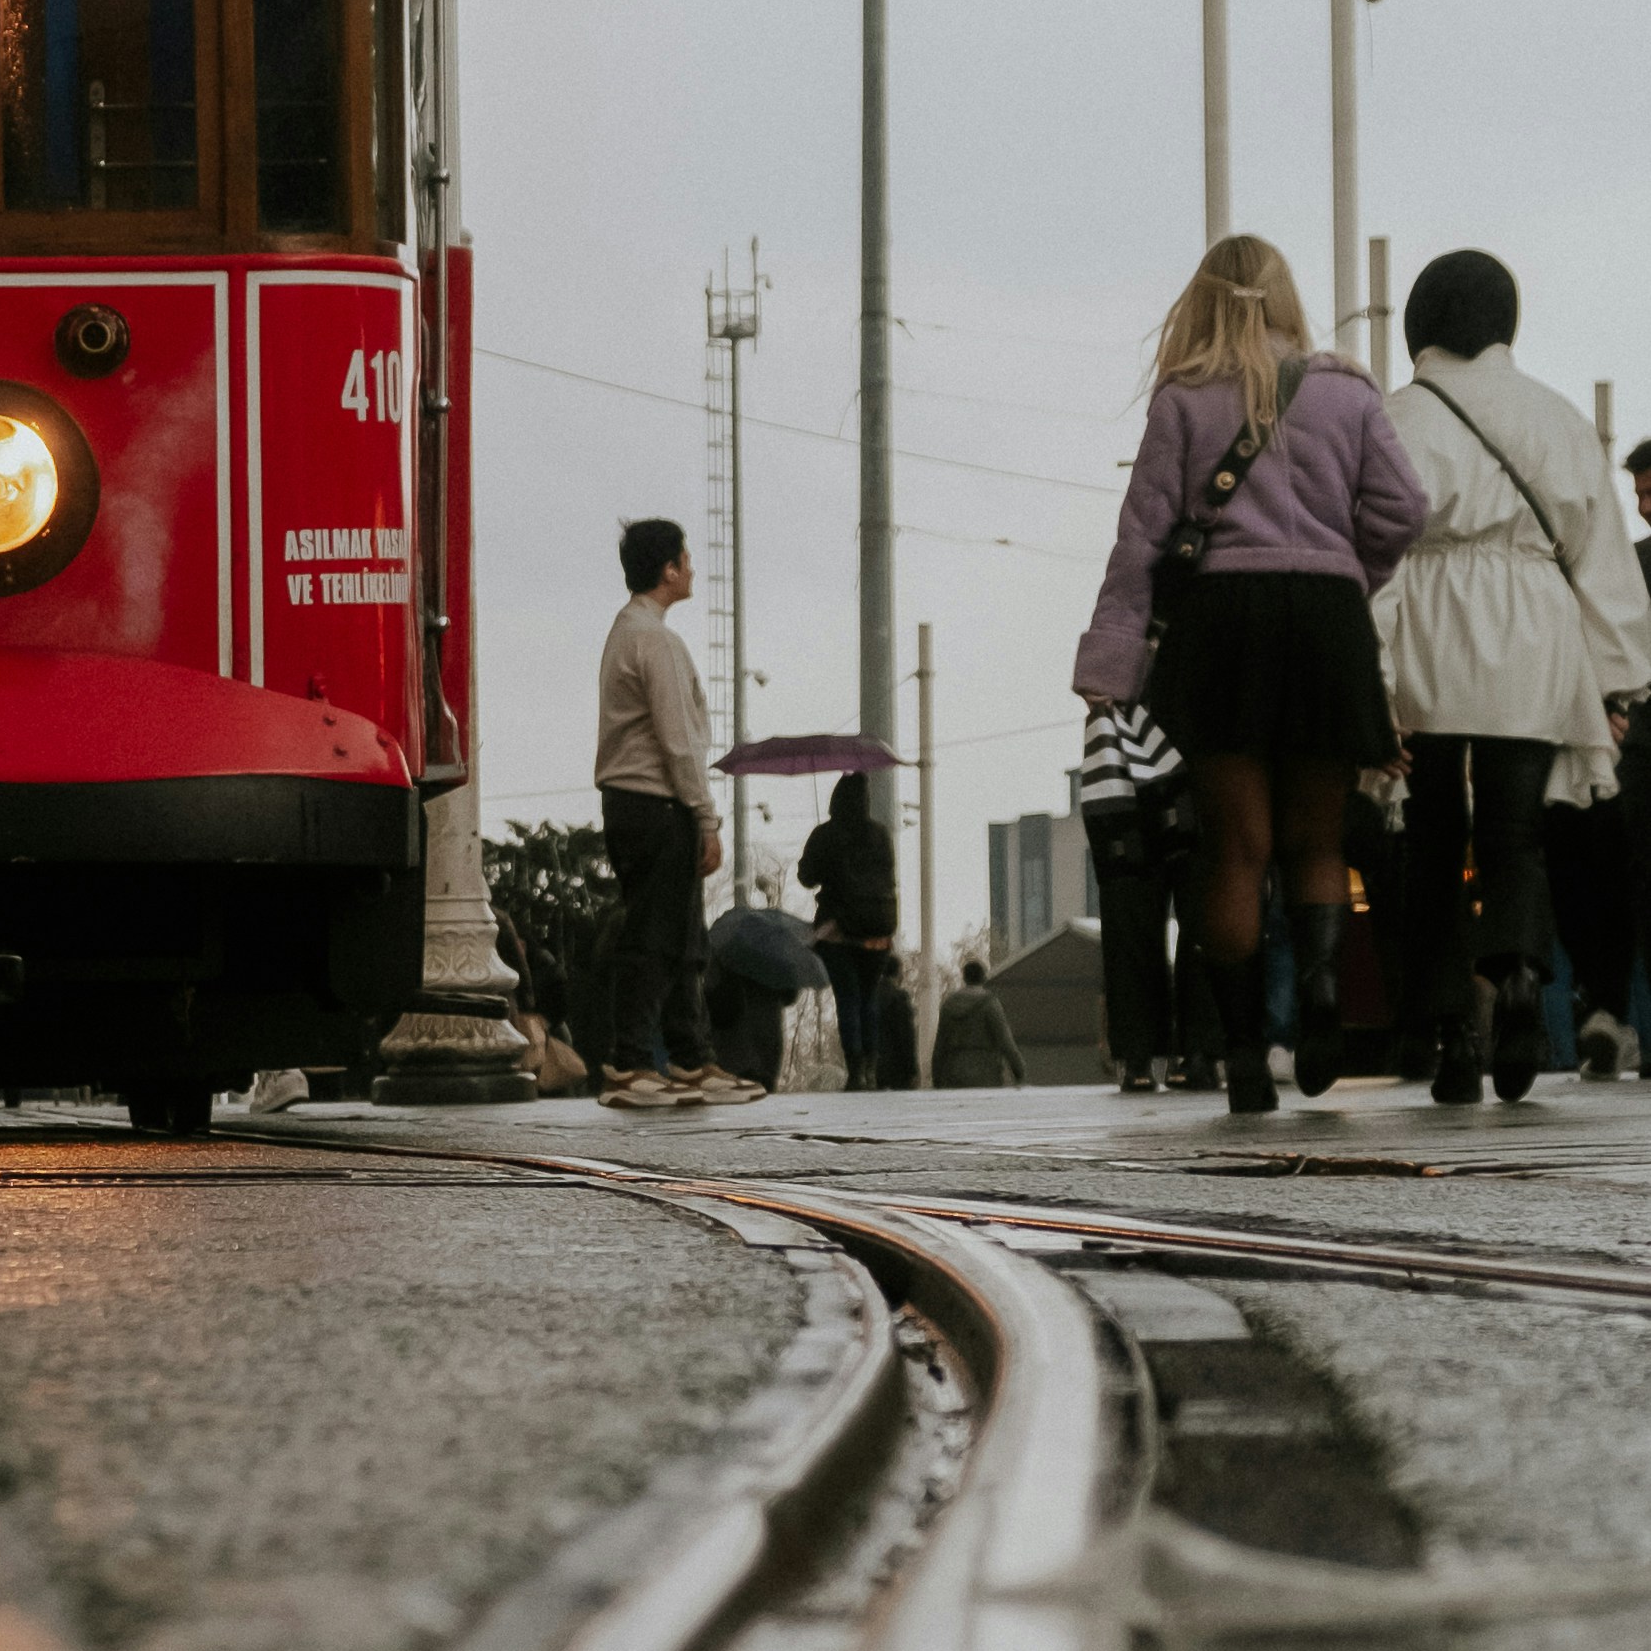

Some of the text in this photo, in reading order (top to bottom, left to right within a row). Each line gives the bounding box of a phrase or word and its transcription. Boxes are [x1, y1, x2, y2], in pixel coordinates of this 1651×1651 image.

[341, 349, 402, 423] 410
[285, 528, 373, 562] ASILMAK
[287, 574, 314, 605] VE
